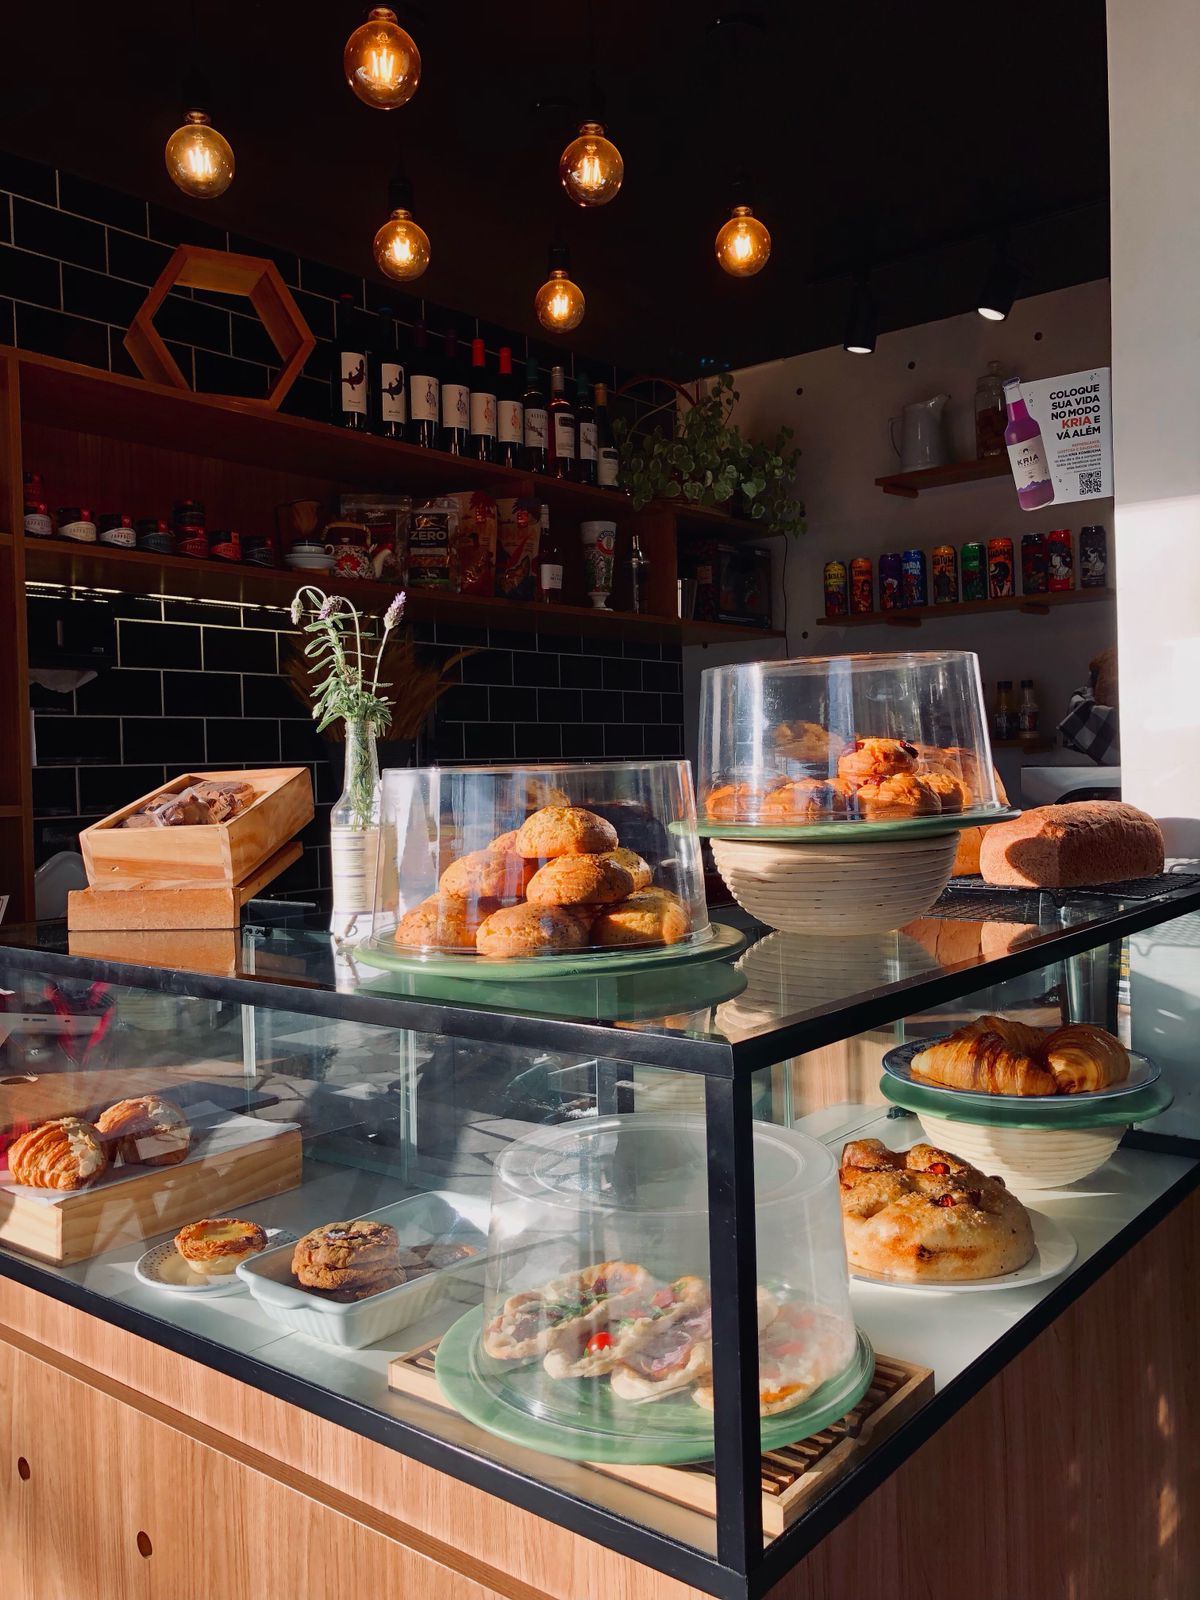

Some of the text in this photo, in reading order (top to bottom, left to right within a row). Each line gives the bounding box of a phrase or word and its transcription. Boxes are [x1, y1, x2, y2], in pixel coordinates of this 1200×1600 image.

[1049, 384, 1100, 400] COLOQUE
[1051, 395, 1100, 410] SUA VIDA
[1051, 405, 1100, 421] NO MODO
[1062, 415, 1100, 429] KRIA E
[1056, 425, 1101, 440] VÁ ALÉM
[1017, 454, 1039, 466] KRIA
[409, 530, 447, 541] ZERO
